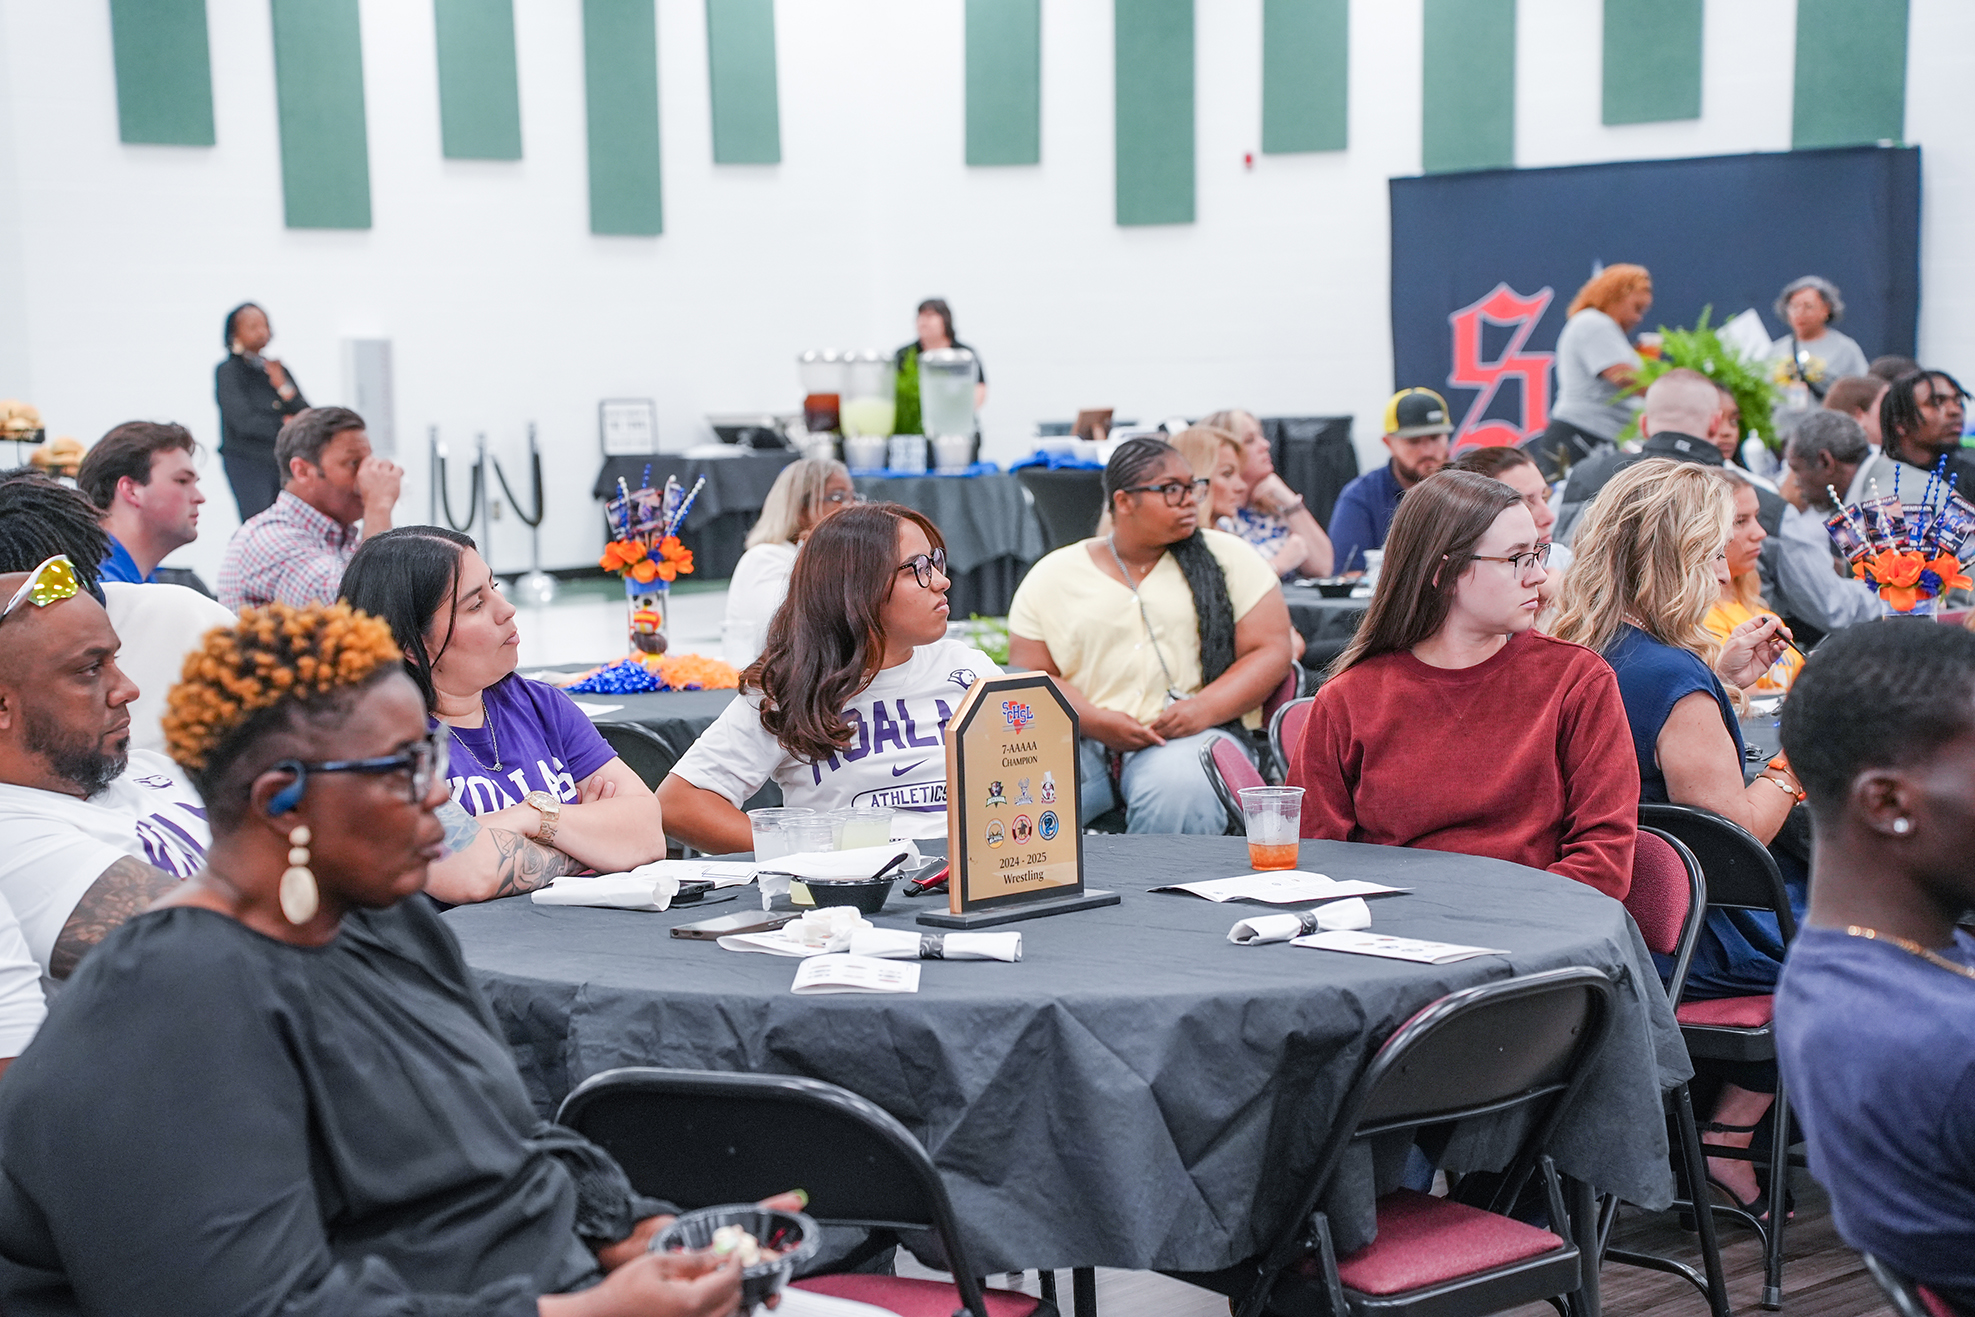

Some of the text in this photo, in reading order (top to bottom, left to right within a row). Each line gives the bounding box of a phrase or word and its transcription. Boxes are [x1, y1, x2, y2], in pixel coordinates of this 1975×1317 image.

[1002, 701, 1034, 724] SCHSL
[1002, 741, 1037, 754] 7-AAAAA
[1000, 856, 1020, 869] 2024
[1027, 852, 1047, 864] 2025
[1003, 870, 1045, 884] Wrestling
